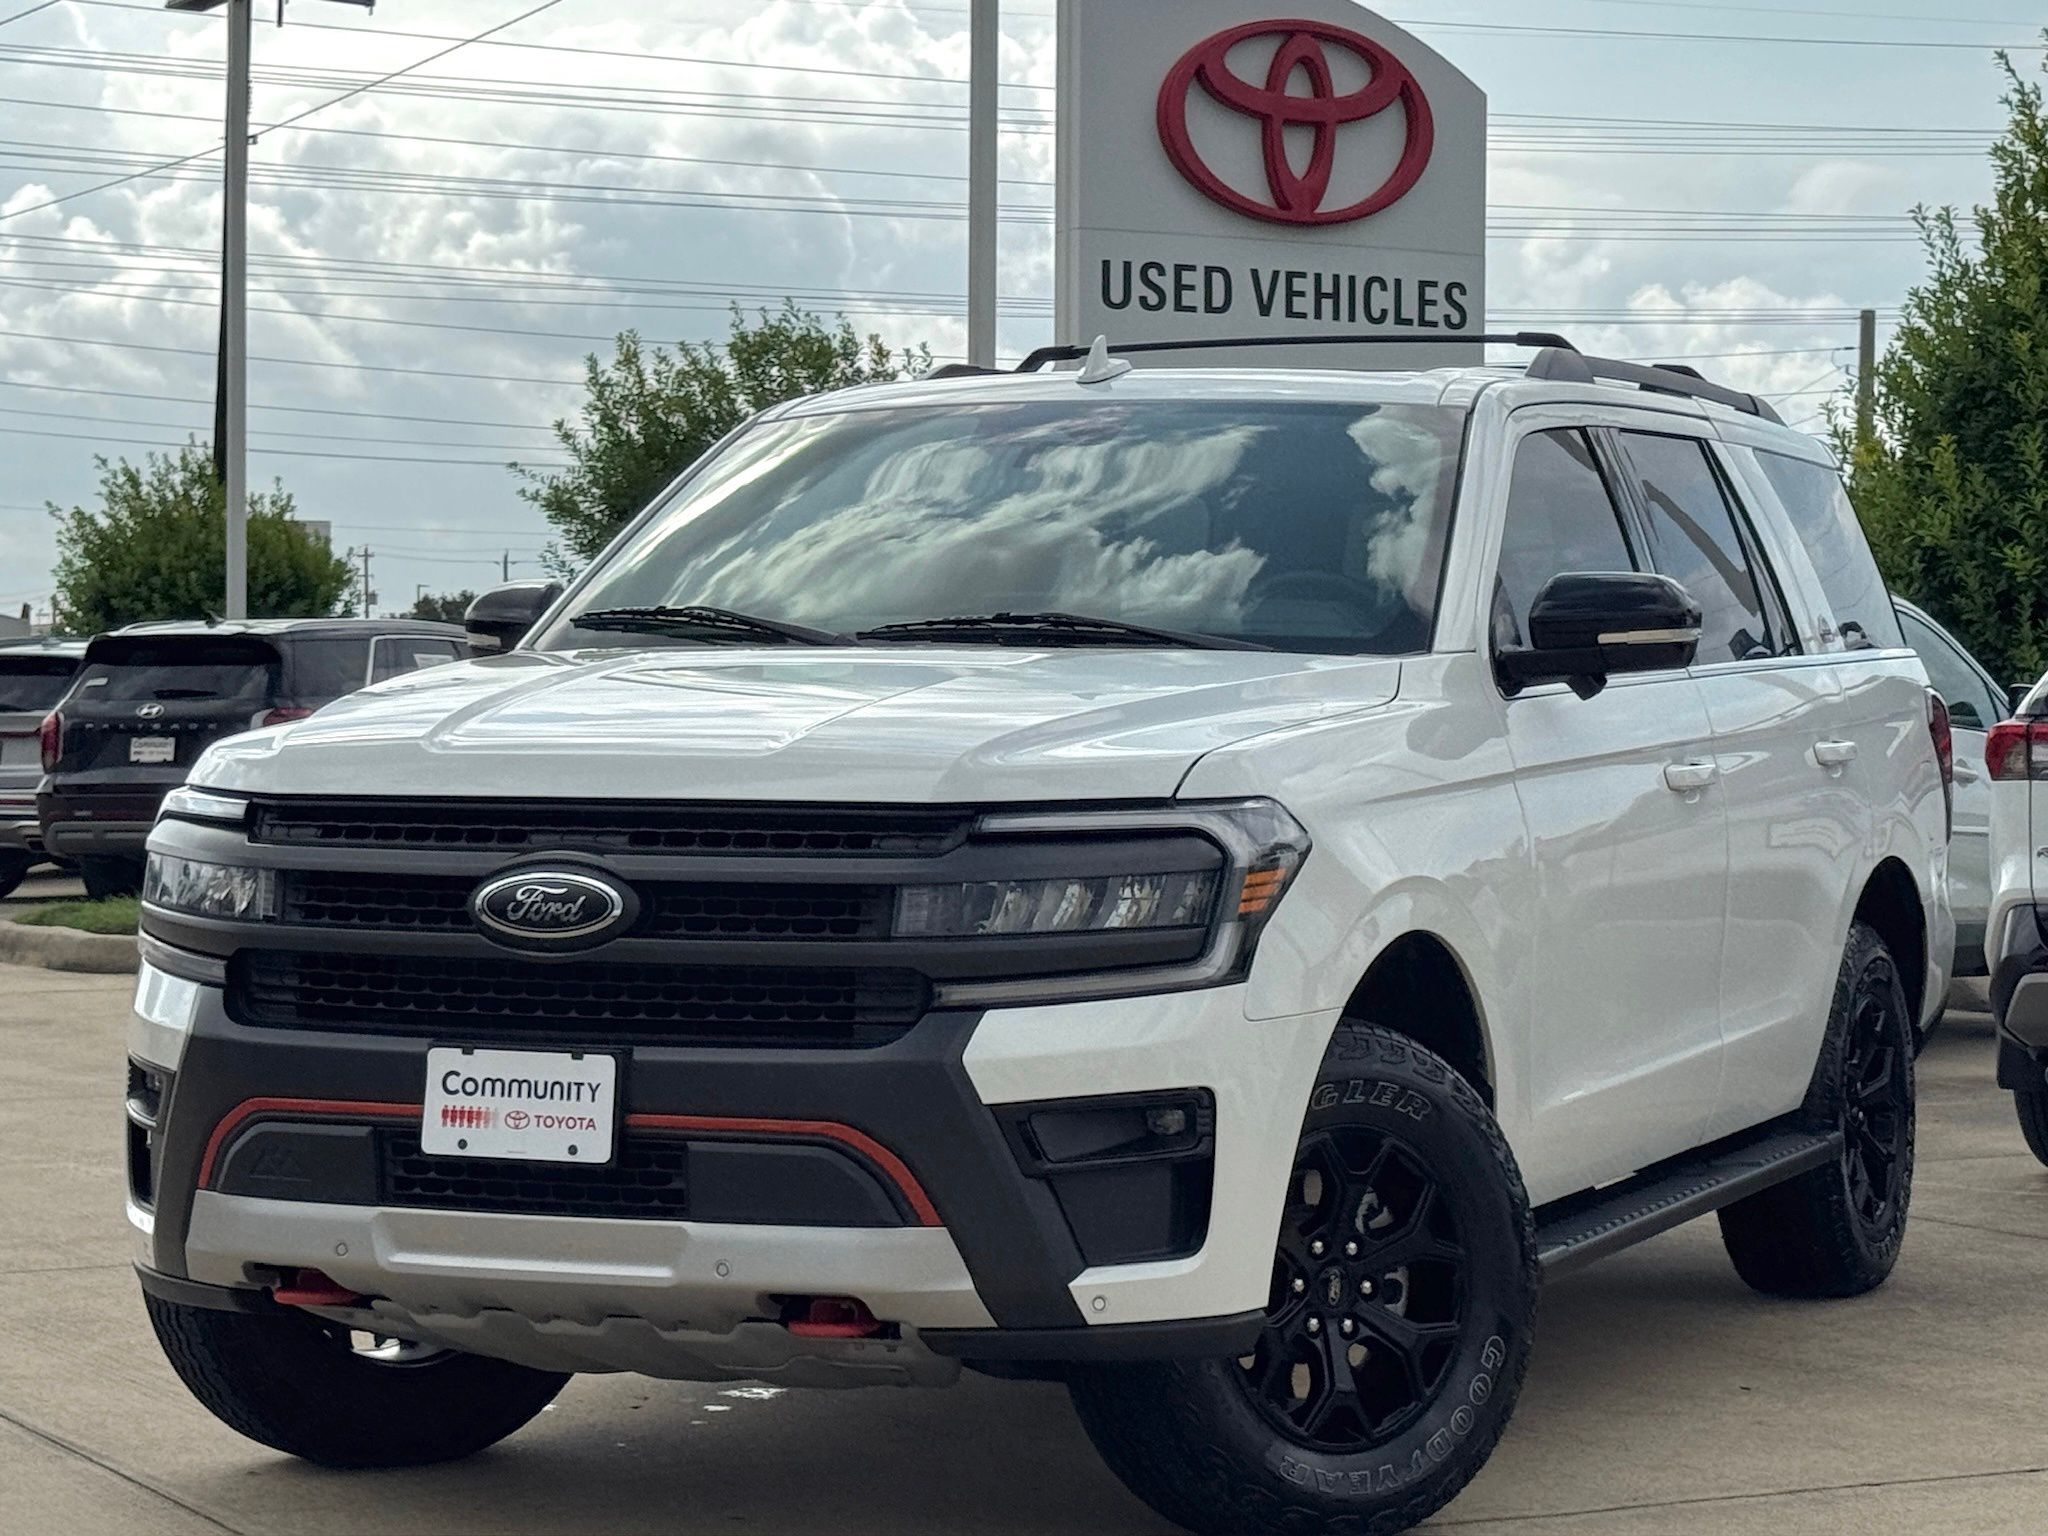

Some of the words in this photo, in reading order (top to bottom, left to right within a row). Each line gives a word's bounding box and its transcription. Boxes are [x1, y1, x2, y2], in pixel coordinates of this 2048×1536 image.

[1101, 259, 1233, 314] USED
[1249, 267, 1468, 330] VEHICLES
[506, 884, 587, 922] Ford
[534, 1114, 597, 1131] TOYOTA
[1279, 1335, 1506, 1494] GOODYEAR
